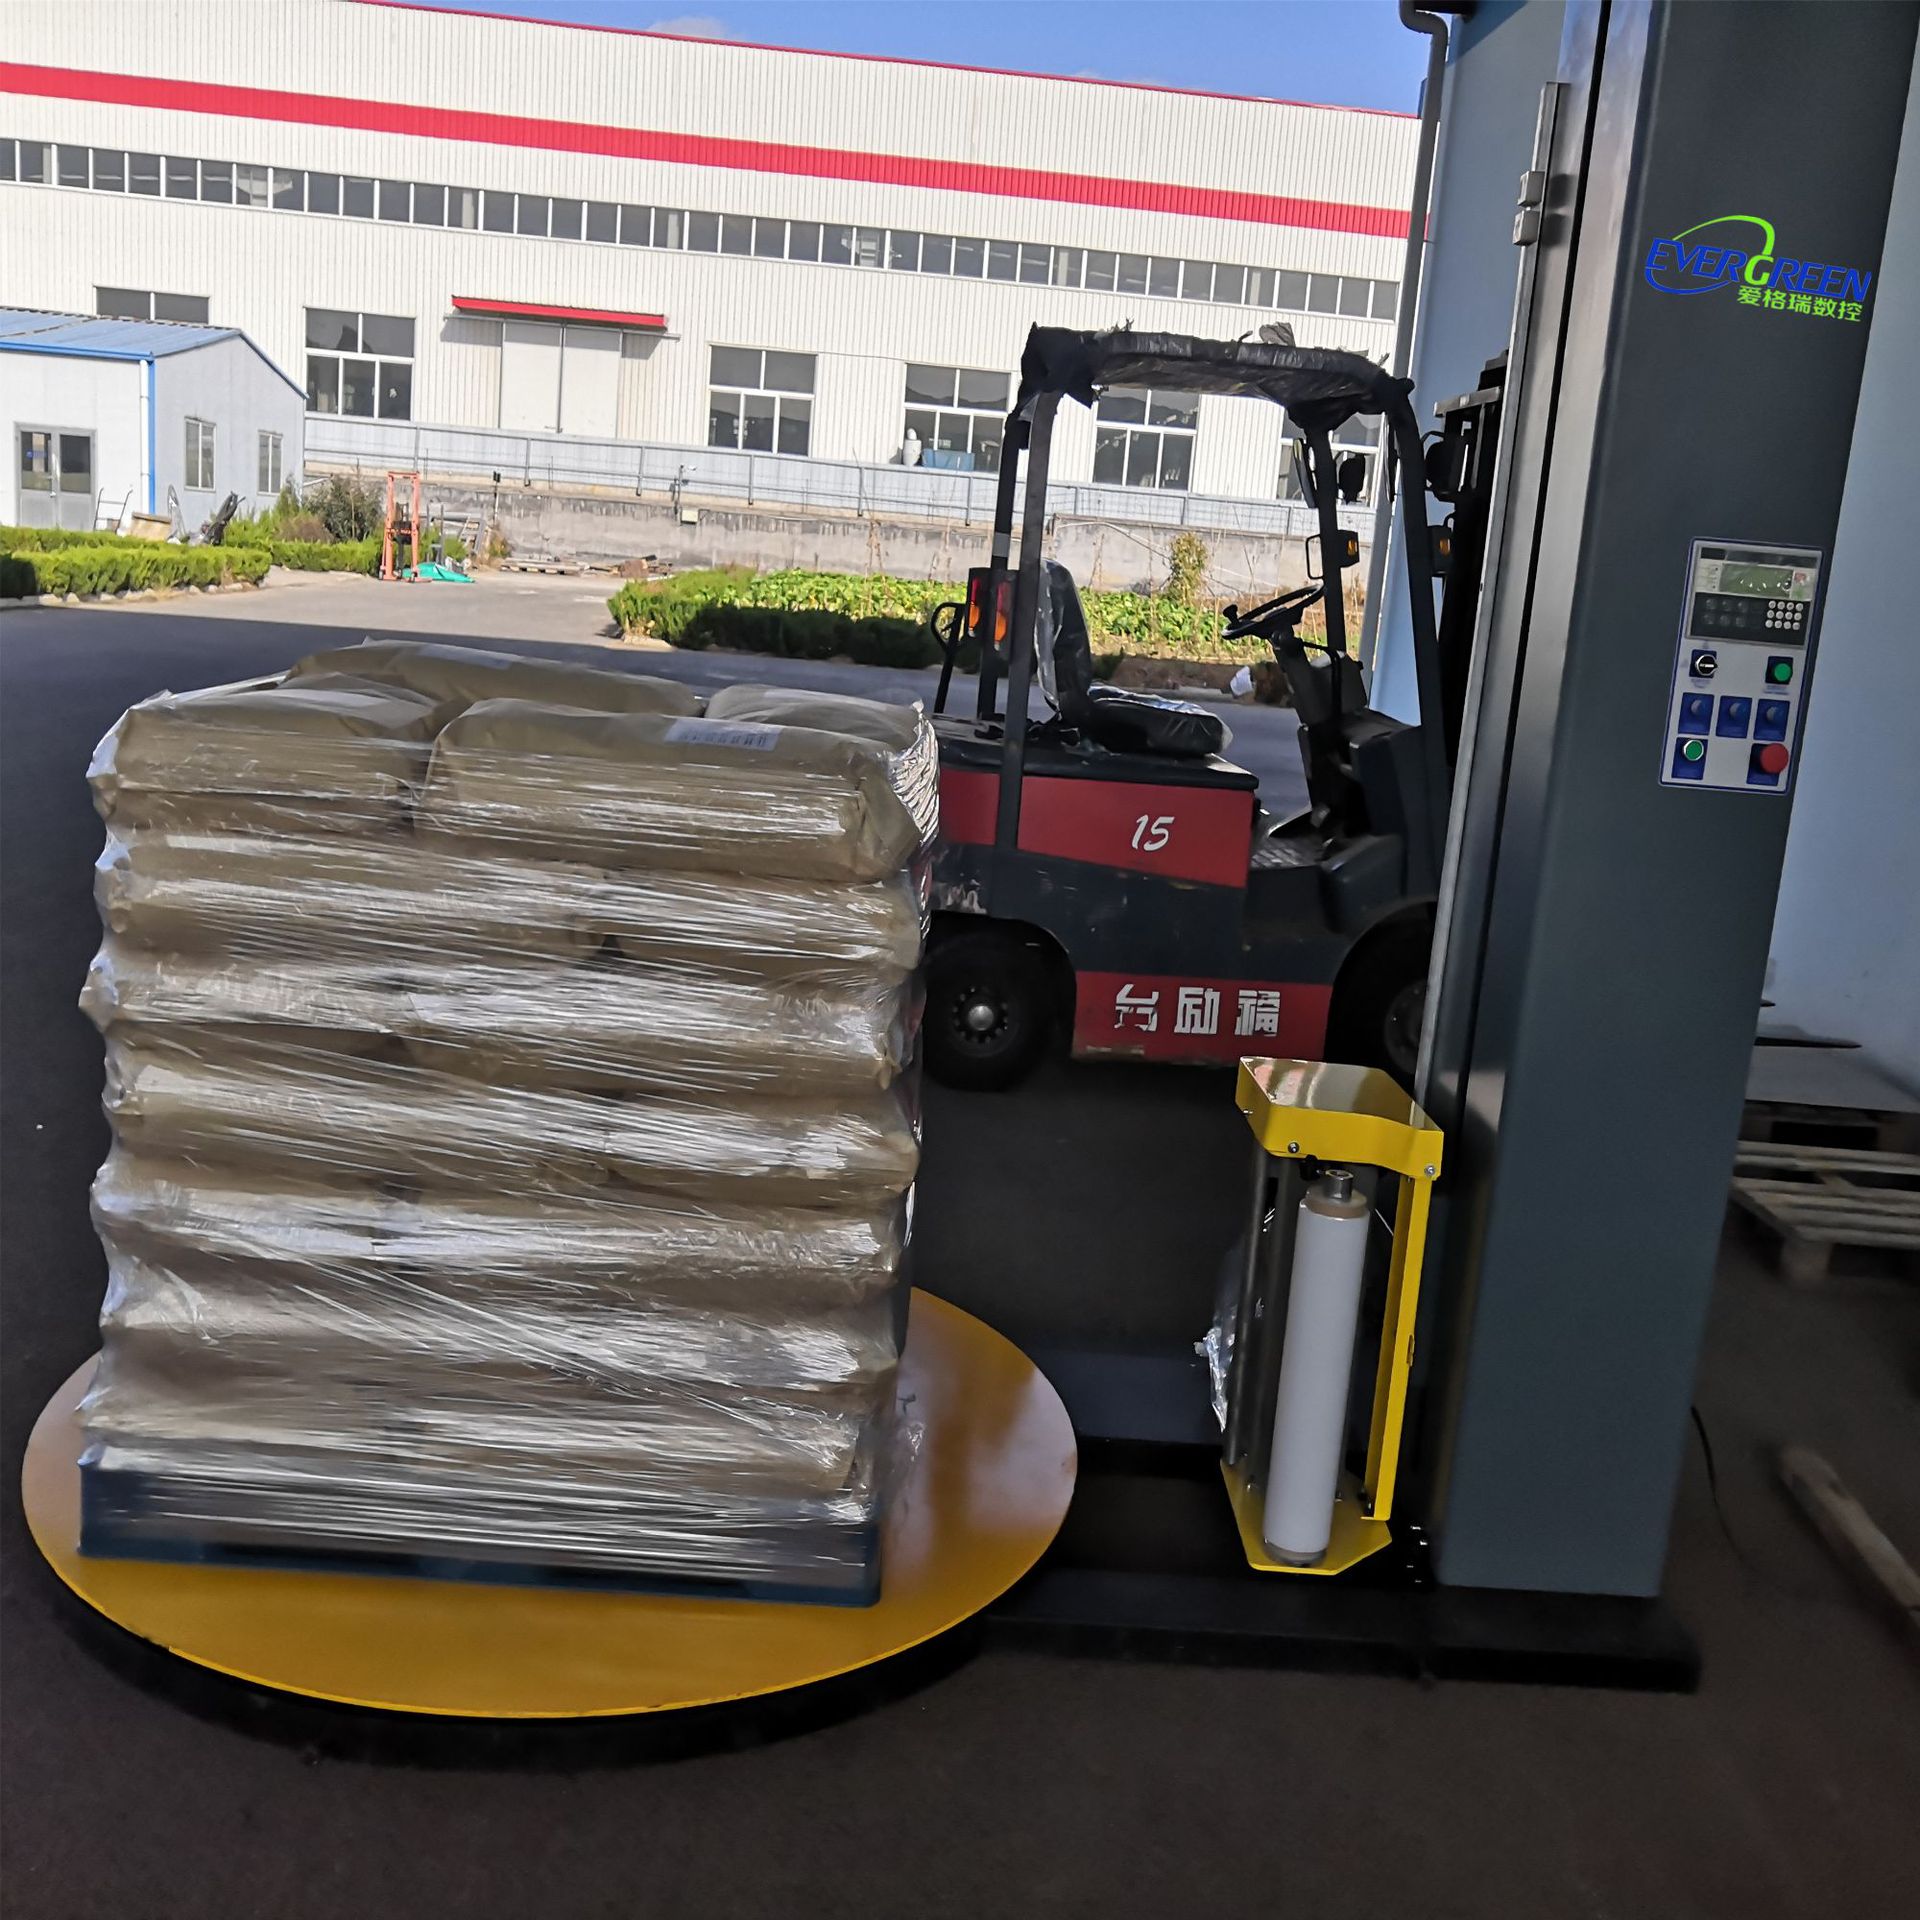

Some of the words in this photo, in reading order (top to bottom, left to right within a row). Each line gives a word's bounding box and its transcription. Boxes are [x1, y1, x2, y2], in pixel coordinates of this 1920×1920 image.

[1132, 814, 1175, 851] 15
[1114, 983, 1281, 1037] 台励福
